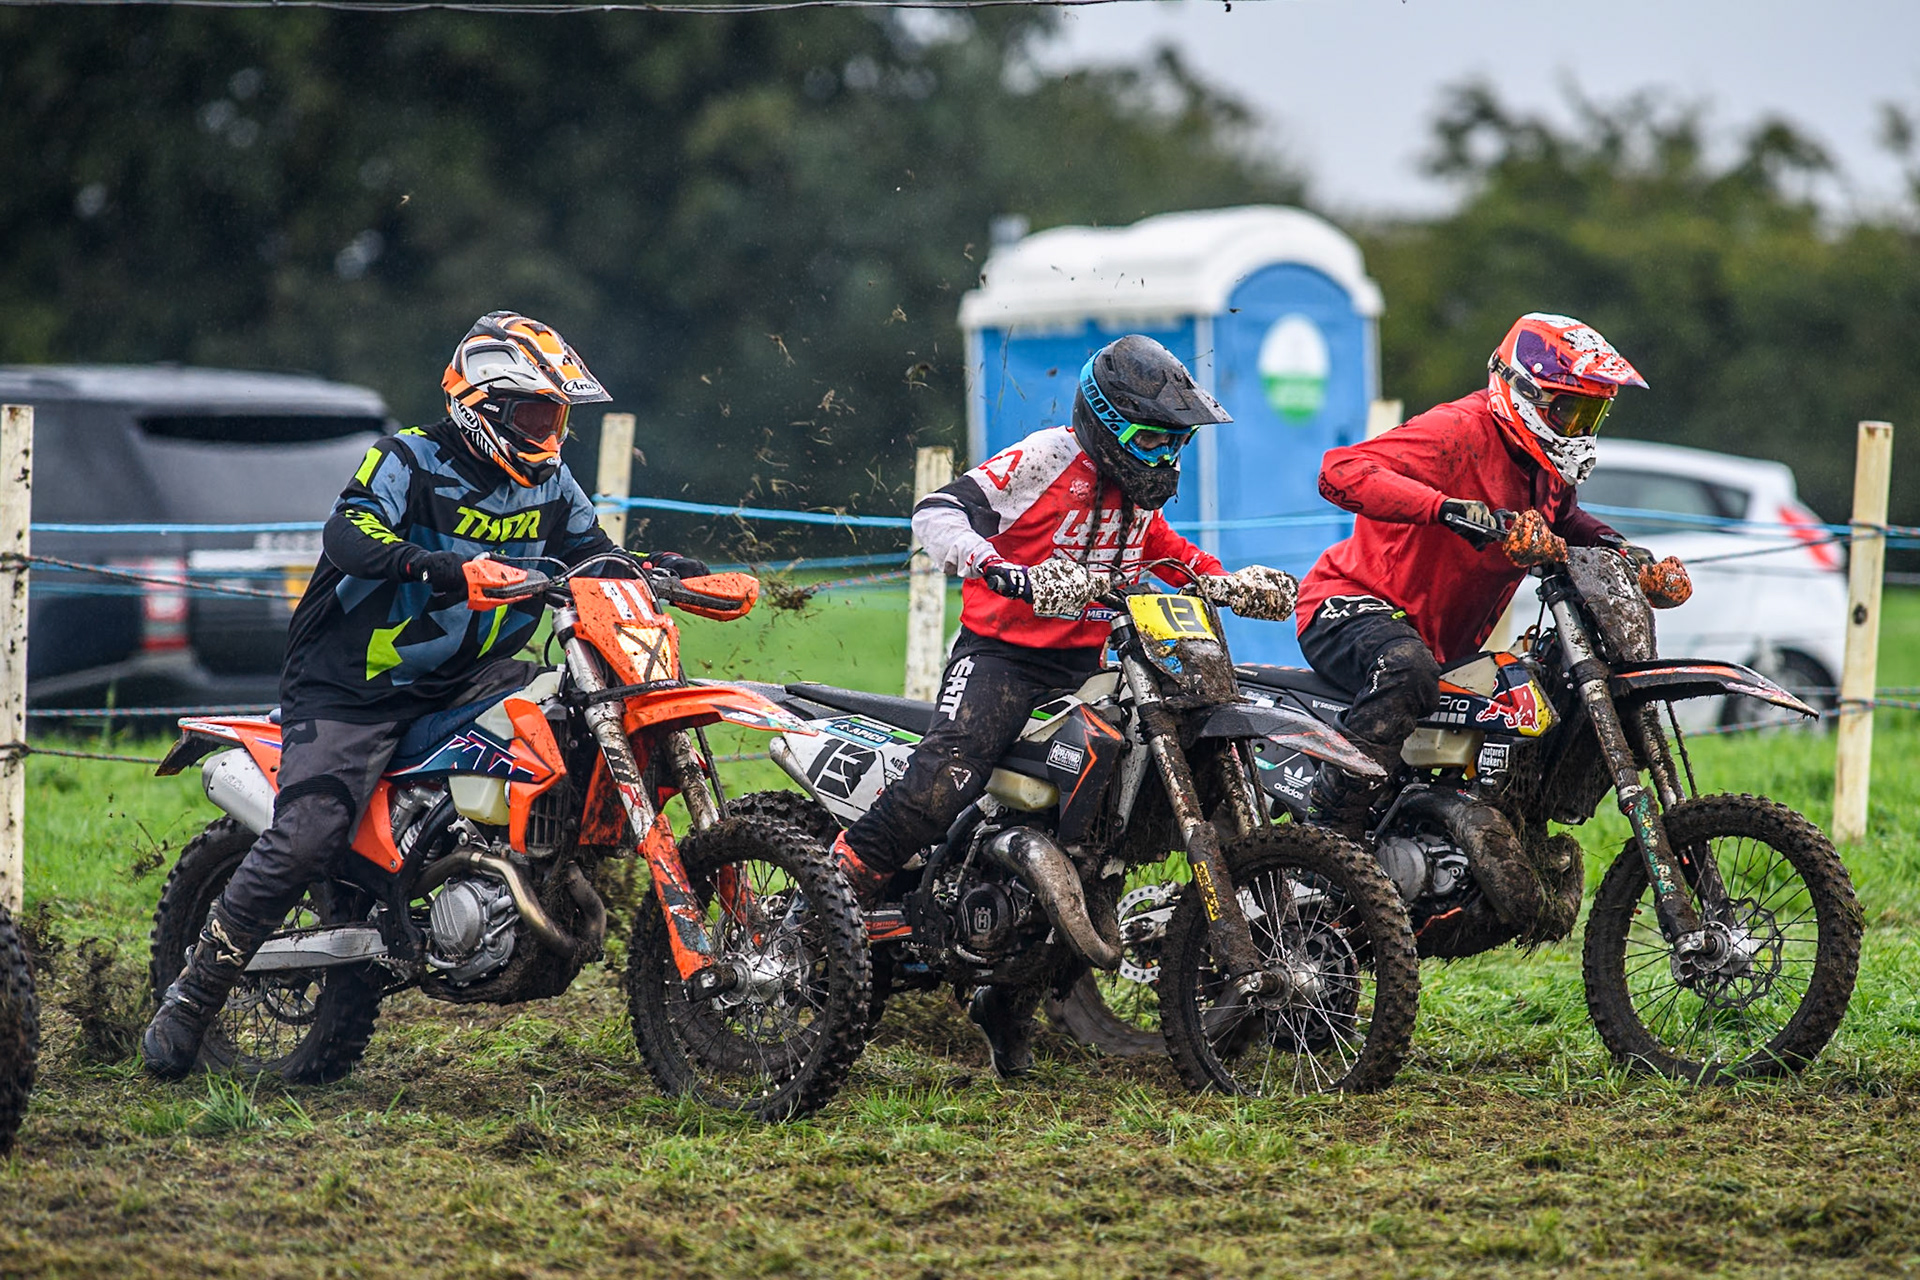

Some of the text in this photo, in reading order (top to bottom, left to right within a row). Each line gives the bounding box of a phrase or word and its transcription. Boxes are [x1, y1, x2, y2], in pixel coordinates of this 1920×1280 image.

[1081, 375, 1125, 433] 100%
[453, 505, 541, 542] THOR
[598, 581, 655, 621] 11
[1156, 596, 1208, 633] 13
[847, 726, 888, 744] APICO
[1273, 782, 1305, 801] adidas
